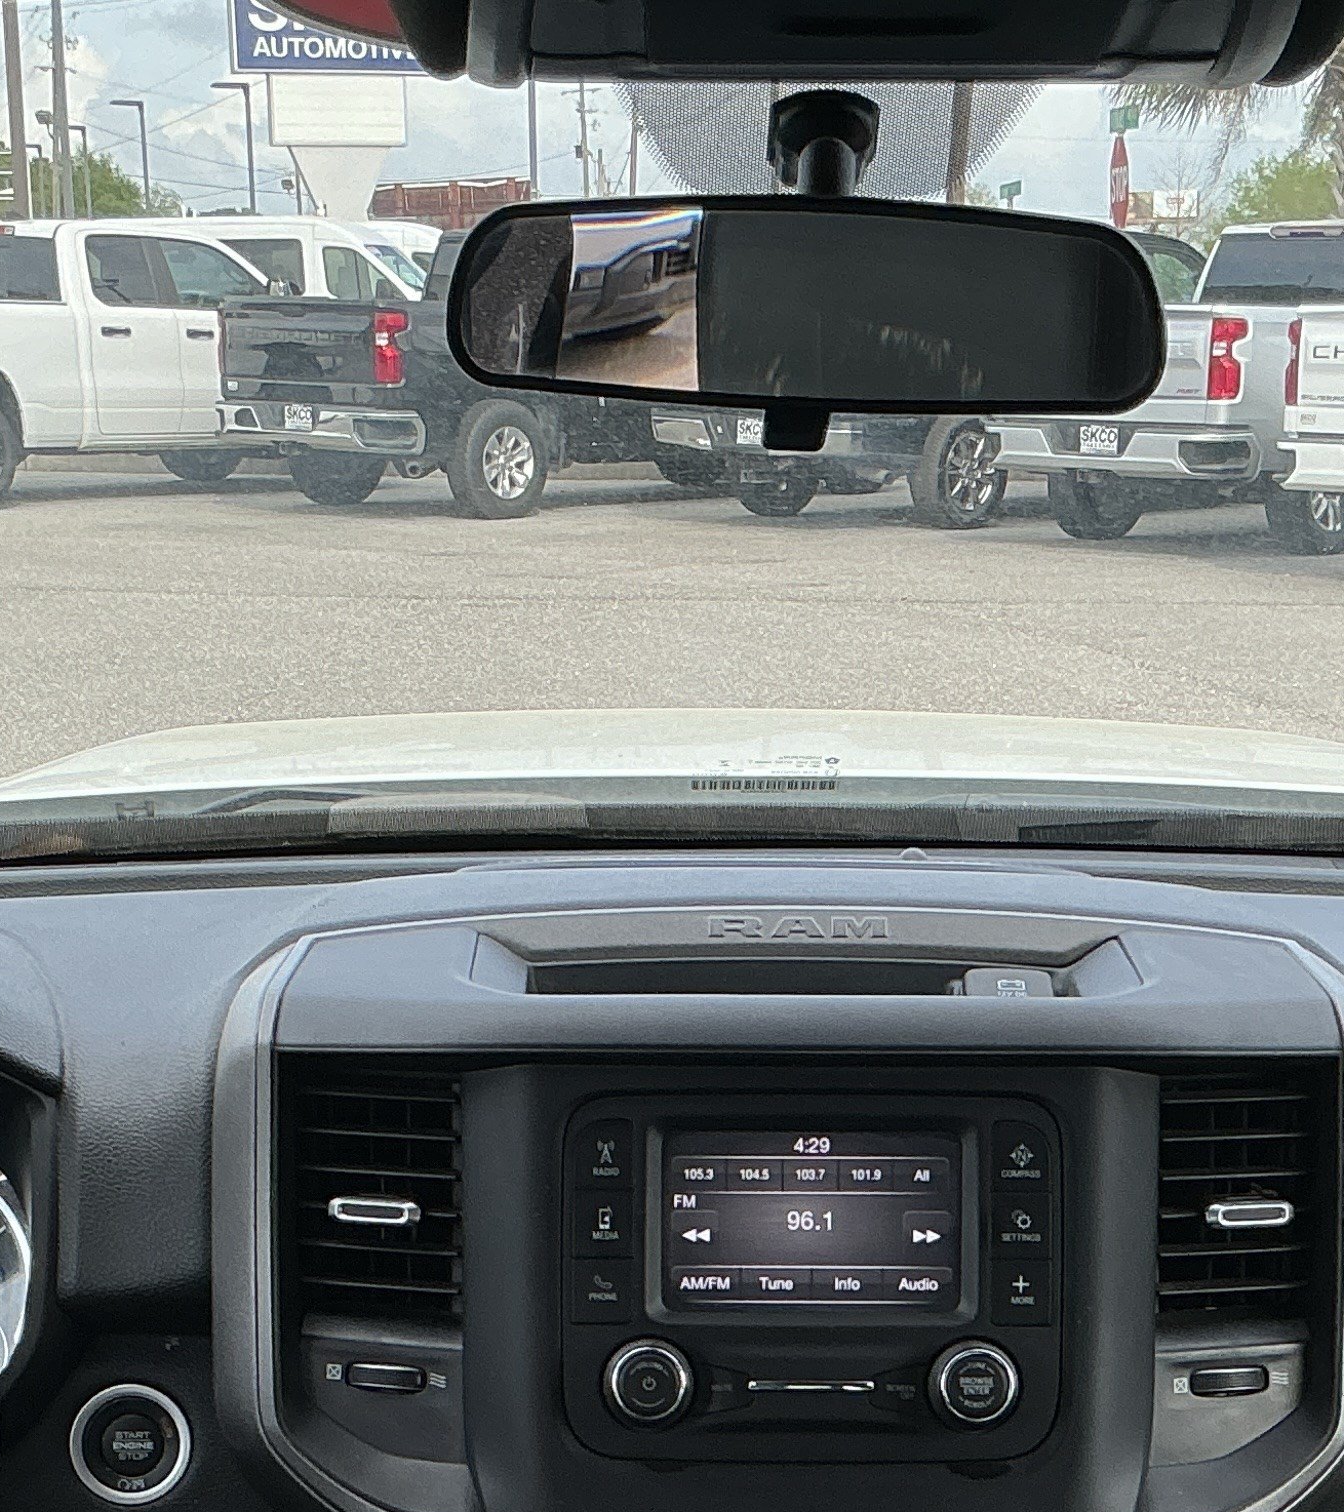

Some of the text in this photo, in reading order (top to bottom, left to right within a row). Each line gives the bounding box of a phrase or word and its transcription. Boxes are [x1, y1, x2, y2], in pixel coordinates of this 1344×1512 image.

[1112, 166, 1127, 203] STOP
[1081, 426, 1118, 444] SKCO
[708, 914, 889, 939] RAM
[794, 1137, 831, 1154] 4:29
[592, 1167, 620, 1176] RADIO
[740, 1168, 770, 1181] 104.5
[796, 1168, 825, 1181] 103.7
[852, 1168, 882, 1181] 101.9
[913, 1169, 931, 1182] All
[1001, 1169, 1041, 1178] COMPASS
[673, 1194, 697, 1209] FM
[787, 1210, 834, 1232] 96.1
[592, 1231, 619, 1239] MEDIA
[1001, 1233, 1041, 1242] SETTINGS
[680, 1276, 940, 1293] AM/FM Tune Info Audio
[588, 1292, 618, 1301] PHONE
[1010, 1296, 1035, 1305] MORE
[116, 1430, 151, 1440] START
[112, 1440, 155, 1451] ENGINE
[117, 1451, 149, 1461] STOP
